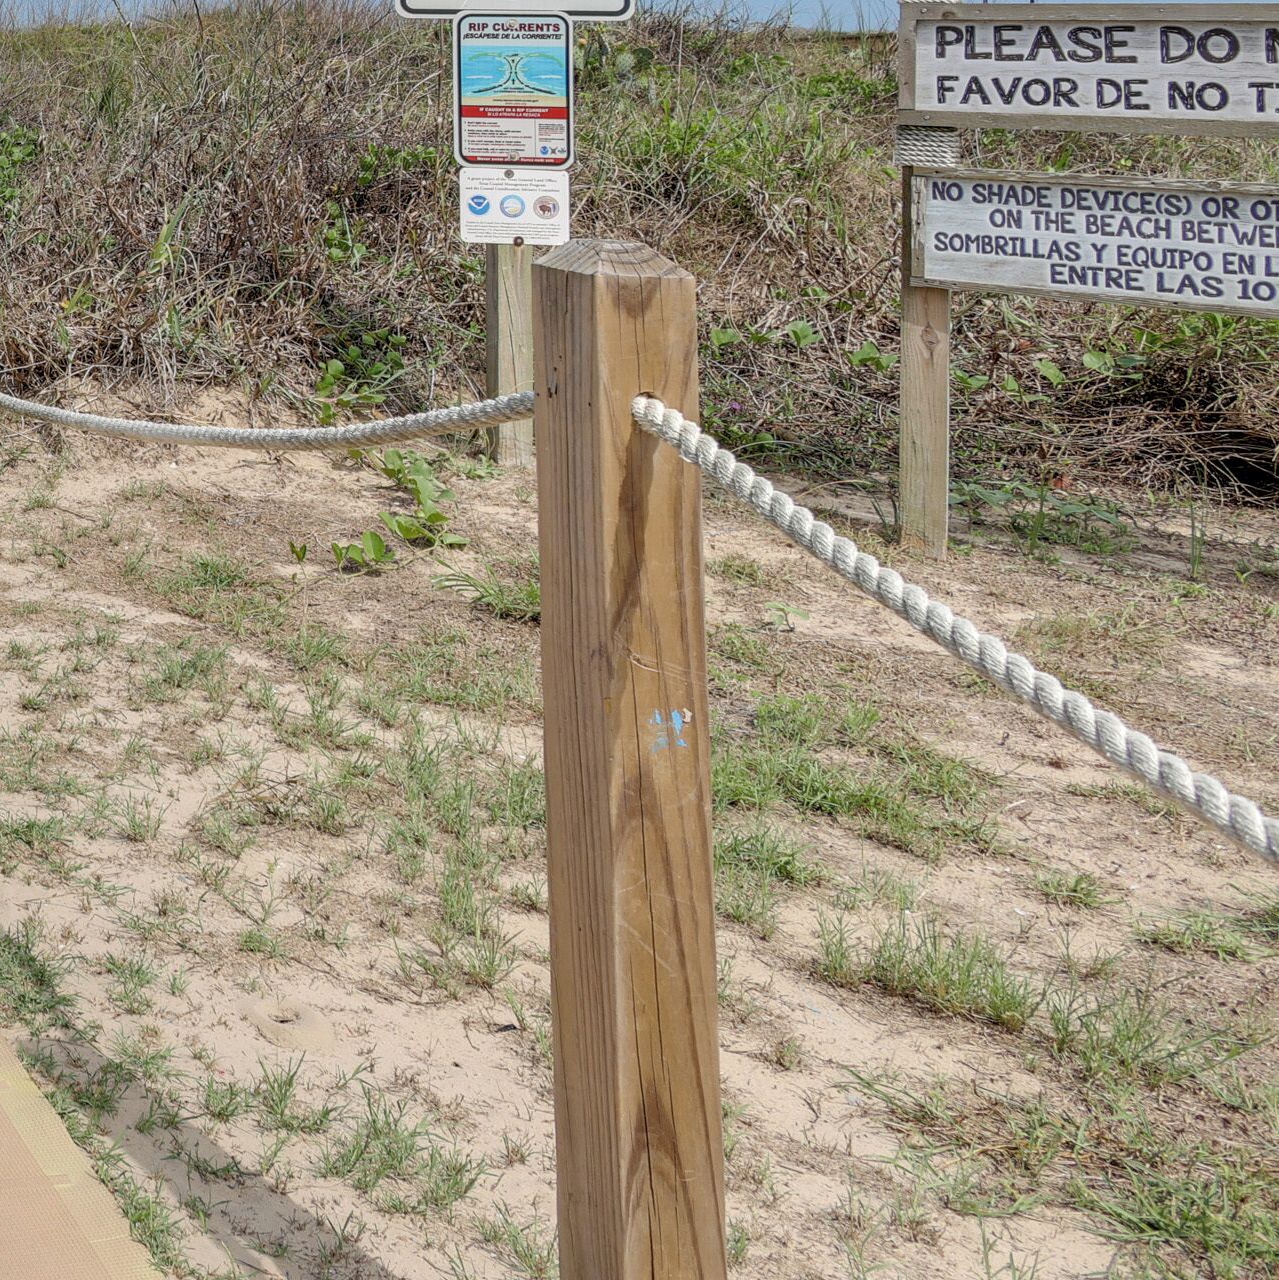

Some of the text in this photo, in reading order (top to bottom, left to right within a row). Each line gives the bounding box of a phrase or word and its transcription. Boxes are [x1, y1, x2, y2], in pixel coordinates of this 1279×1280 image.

[469, 23, 560, 32] RIP CURENTS
[935, 25, 1138, 64] PLEASE
[1160, 26, 1239, 64] DO
[937, 76, 1080, 108] FAVOR
[1097, 79, 1151, 110] DE
[1168, 81, 1229, 111] NO
[932, 182, 964, 201] NO
[972, 183, 1053, 208] SHADE
[1060, 188, 1192, 216] DEVICE(S)
[1201, 197, 1240, 220] OR
[990, 209, 1022, 229] ON
[1030, 211, 1076, 234] THE
[1086, 214, 1171, 241] BEACH
[934, 232, 1081, 263] SOMBRILLAS
[1091, 243, 1108, 262] Y
[1117, 245, 1213, 271] EQUIPO
[1222, 253, 1262, 275] EN
[1051, 264, 1277, 302] ENTRE LAS 10
